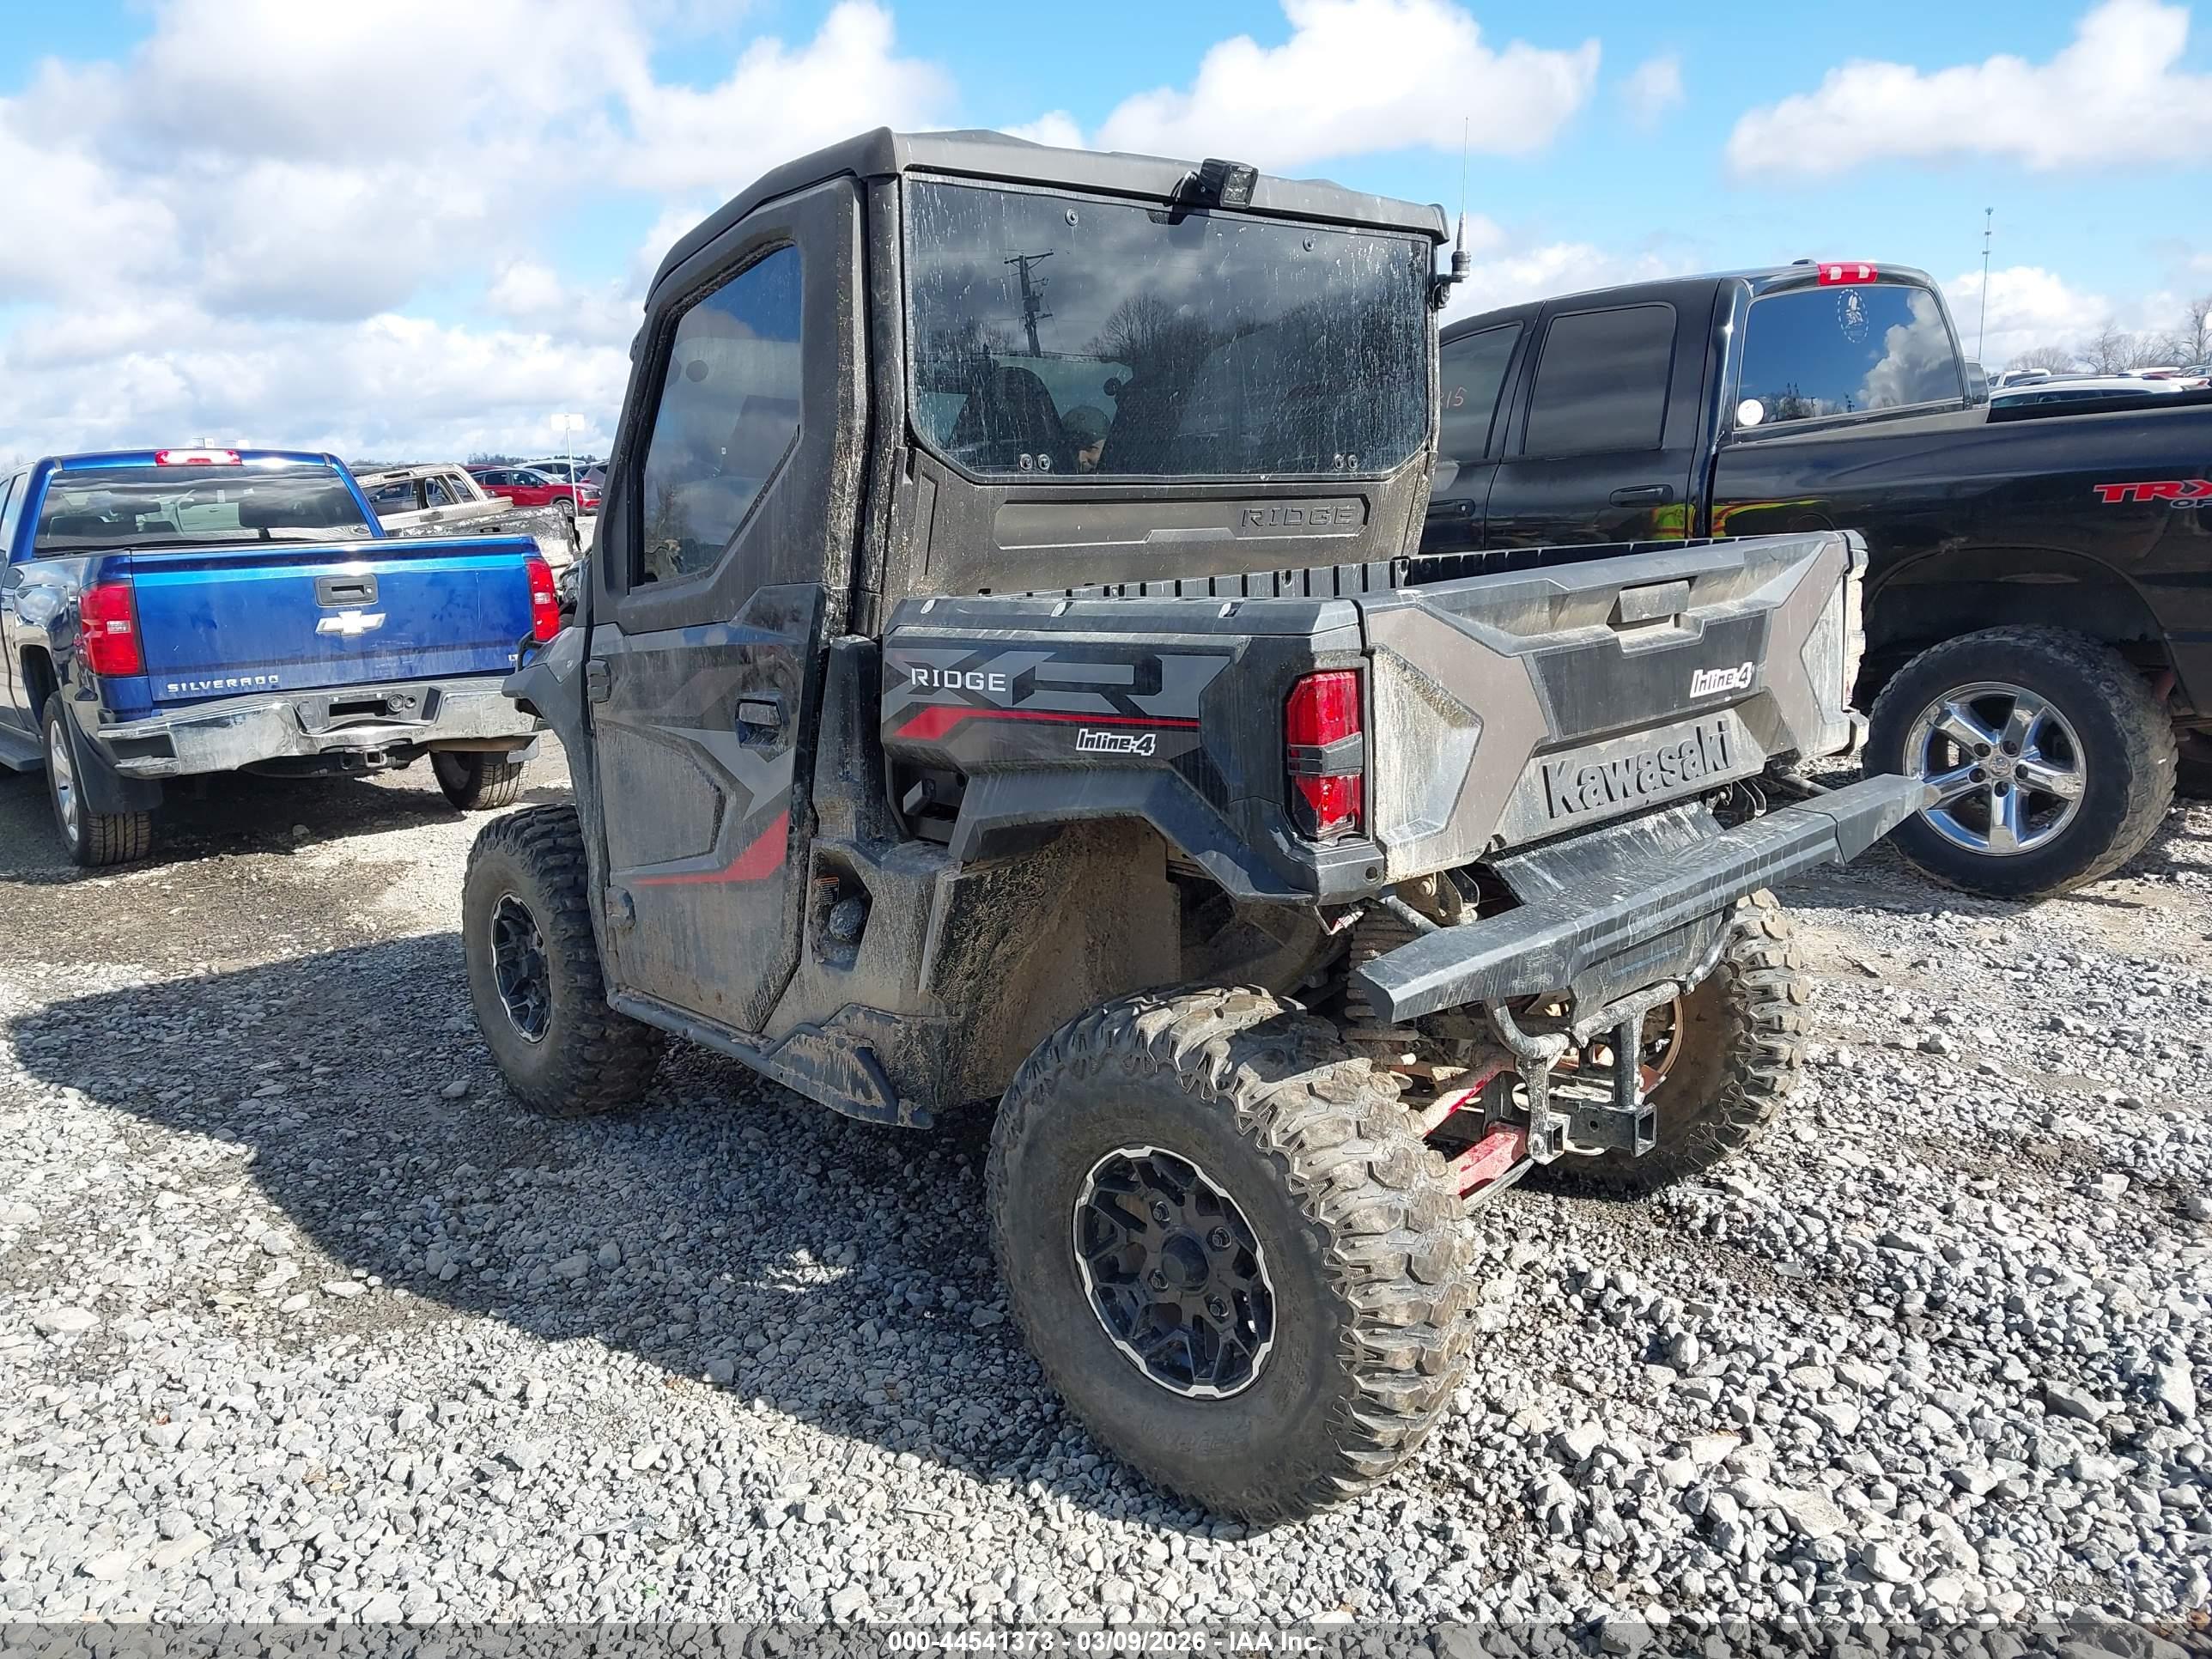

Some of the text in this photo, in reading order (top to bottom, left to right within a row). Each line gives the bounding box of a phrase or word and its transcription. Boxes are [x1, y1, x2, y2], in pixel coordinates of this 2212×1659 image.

[1440, 386, 1468, 410] 15
[1242, 506, 1356, 527] RIDGE
[167, 675, 279, 693] SILVERADO
[910, 668, 1006, 693] RIDGE
[1076, 728, 1156, 757] Inline-4
[1541, 719, 1736, 820] Kawasaki
